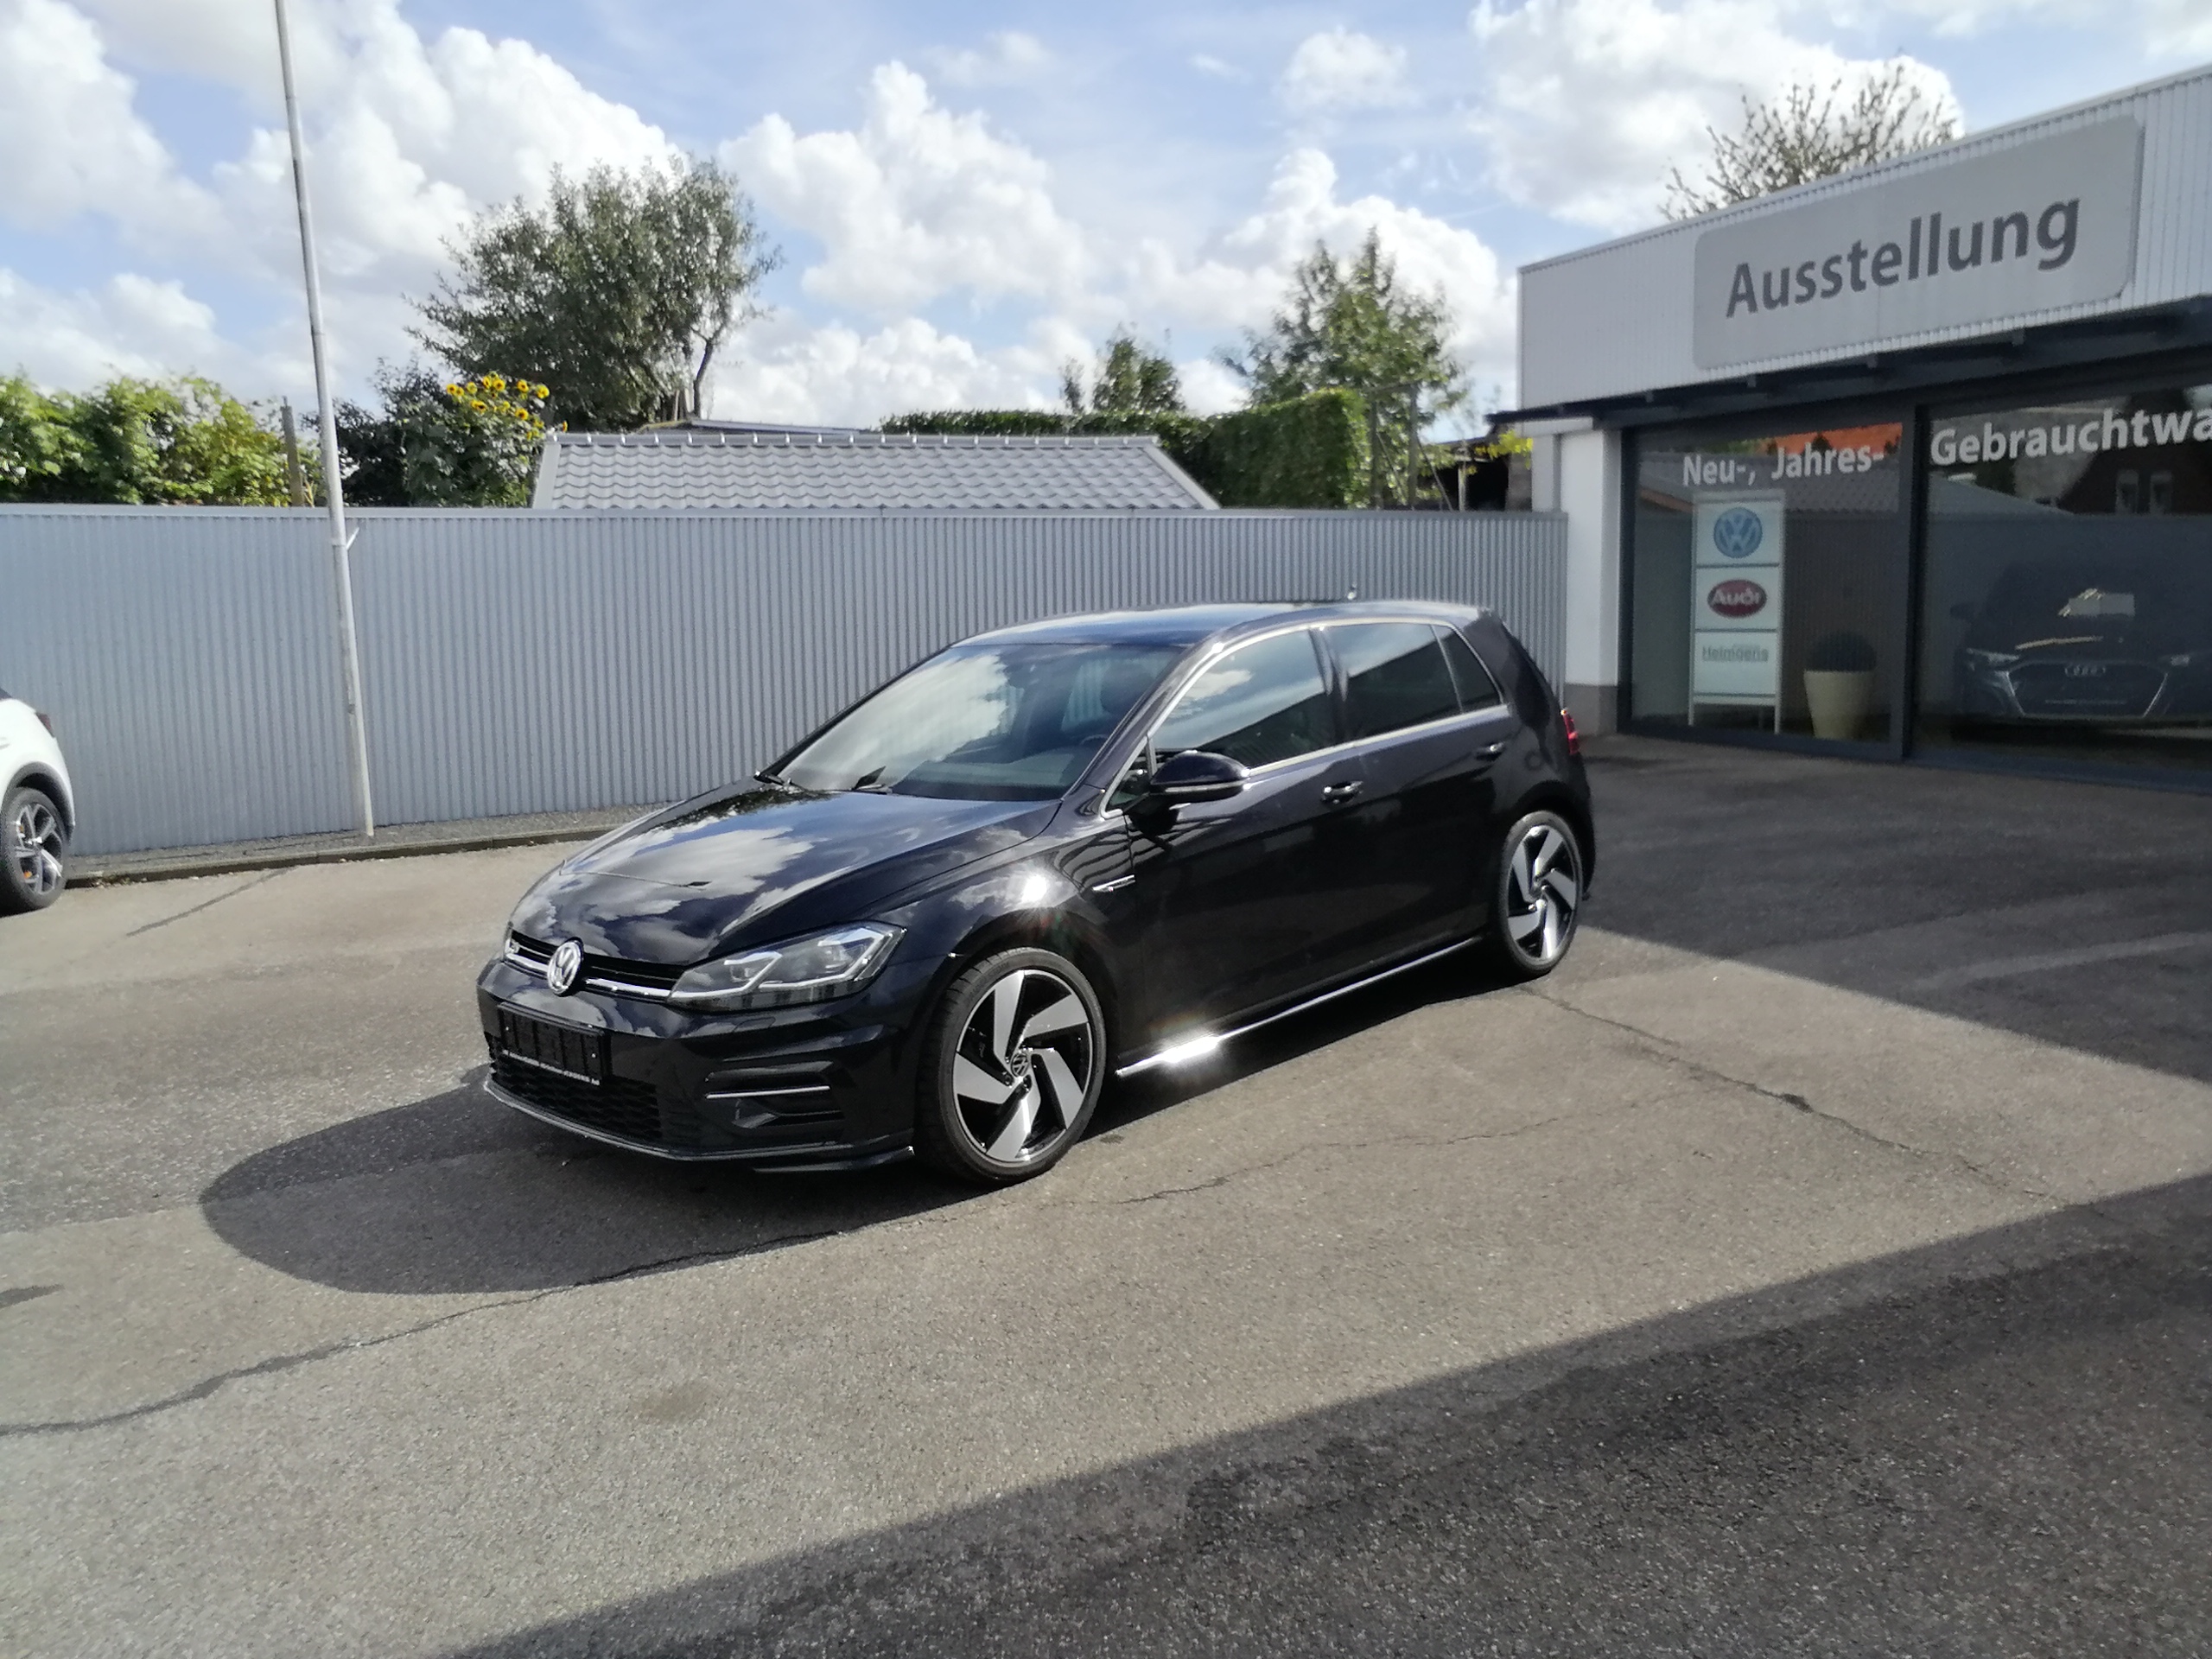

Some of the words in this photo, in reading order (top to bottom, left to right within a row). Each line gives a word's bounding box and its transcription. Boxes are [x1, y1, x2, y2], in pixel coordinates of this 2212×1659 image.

[1726, 198, 2080, 318] Ausstellung
[1682, 454, 1756, 486] Neu-,
[1770, 442, 1885, 480] Jahres-
[1930, 406, 2212, 466] Gebrauchtwa
[1711, 588, 1762, 607] Audi
